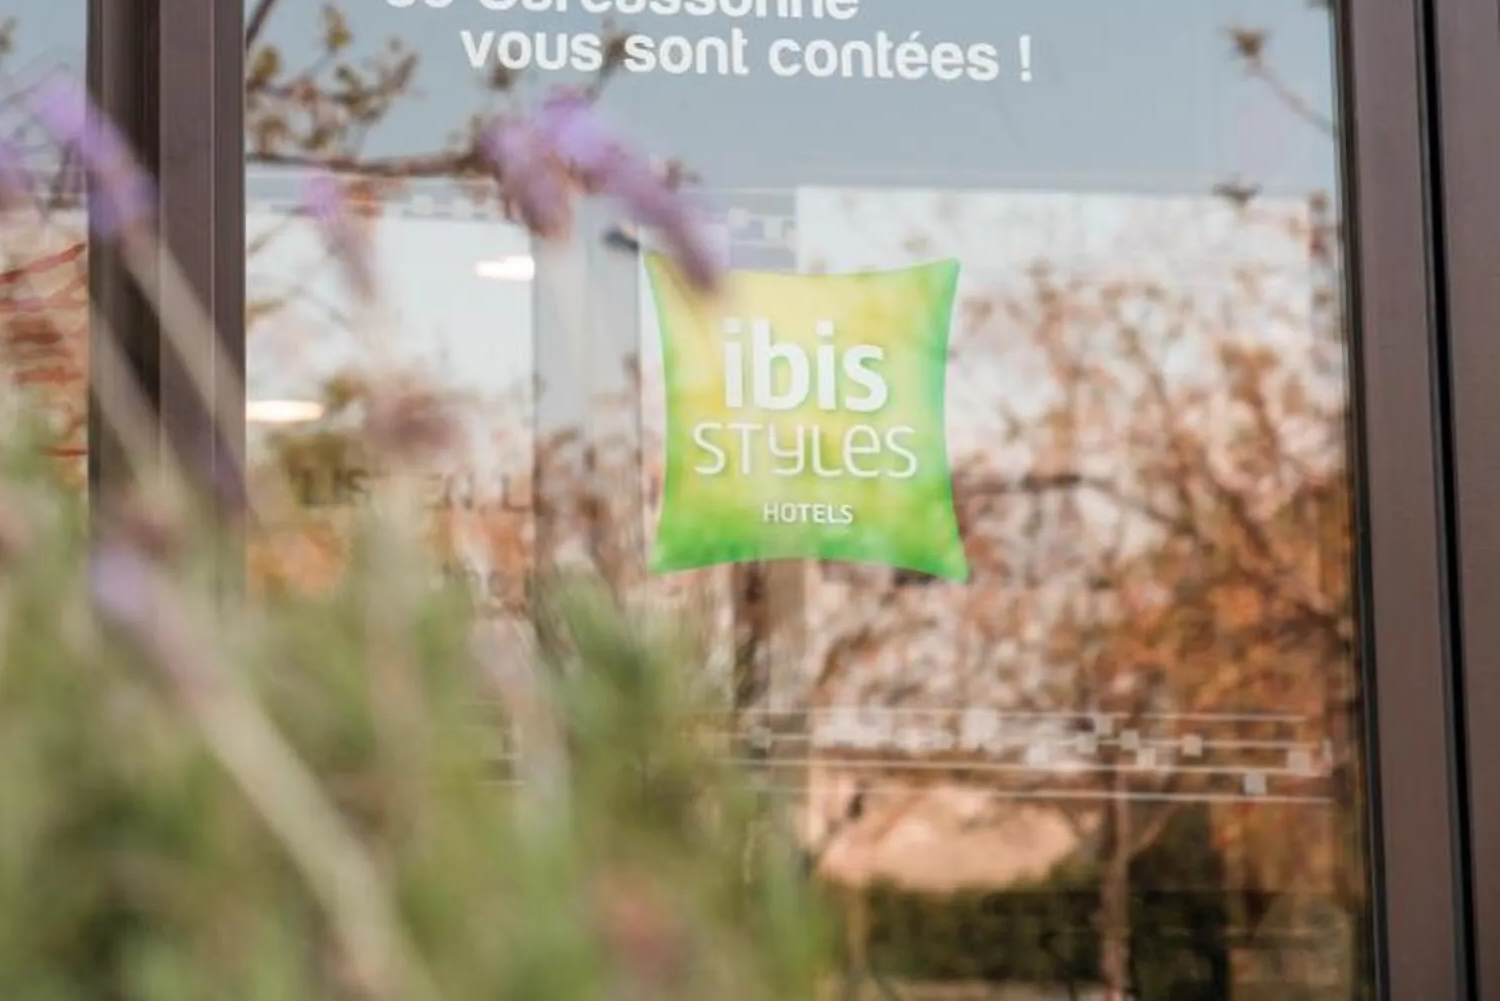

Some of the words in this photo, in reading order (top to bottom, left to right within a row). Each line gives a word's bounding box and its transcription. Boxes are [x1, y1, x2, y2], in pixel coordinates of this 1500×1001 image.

[460, 29, 604, 73] vous
[623, 26, 750, 76] sont
[768, 31, 1000, 81] contées
[1018, 34, 1033, 83] !
[722, 317, 889, 413] ibis
[762, 502, 855, 525] HOTELS
